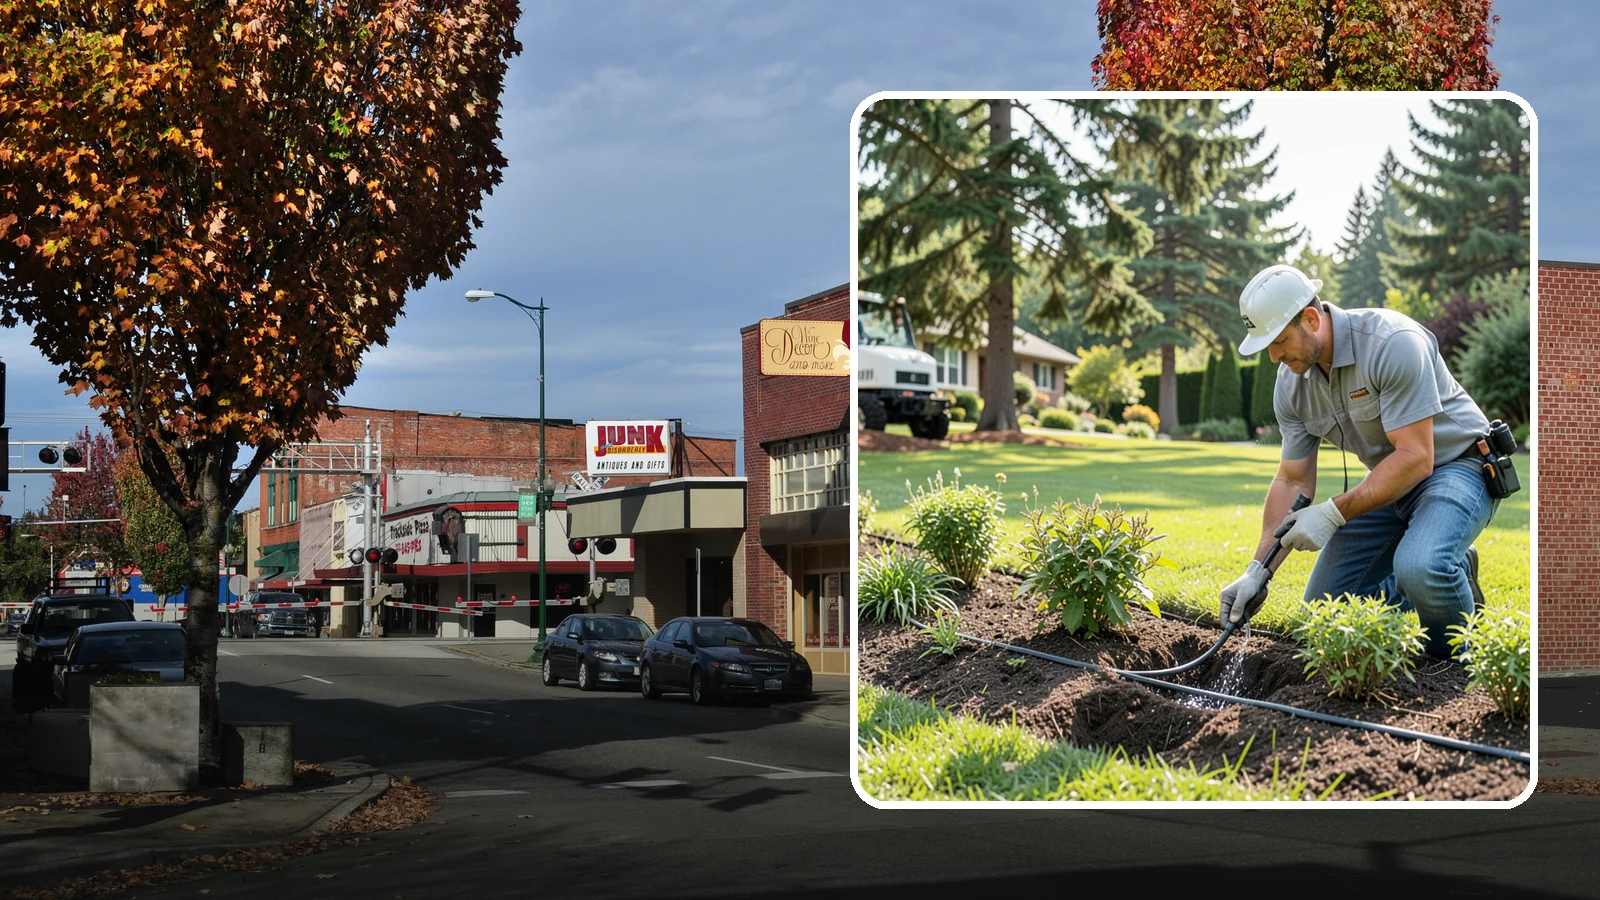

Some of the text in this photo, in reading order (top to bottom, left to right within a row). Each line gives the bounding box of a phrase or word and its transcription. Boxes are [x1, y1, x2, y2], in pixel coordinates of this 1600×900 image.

[595, 425, 665, 457] JUNK
[607, 446, 646, 454] DISORDERLY
[596, 460, 665, 470] ANTIQUES AND GIFTS
[573, 473, 589, 491] RAIL
